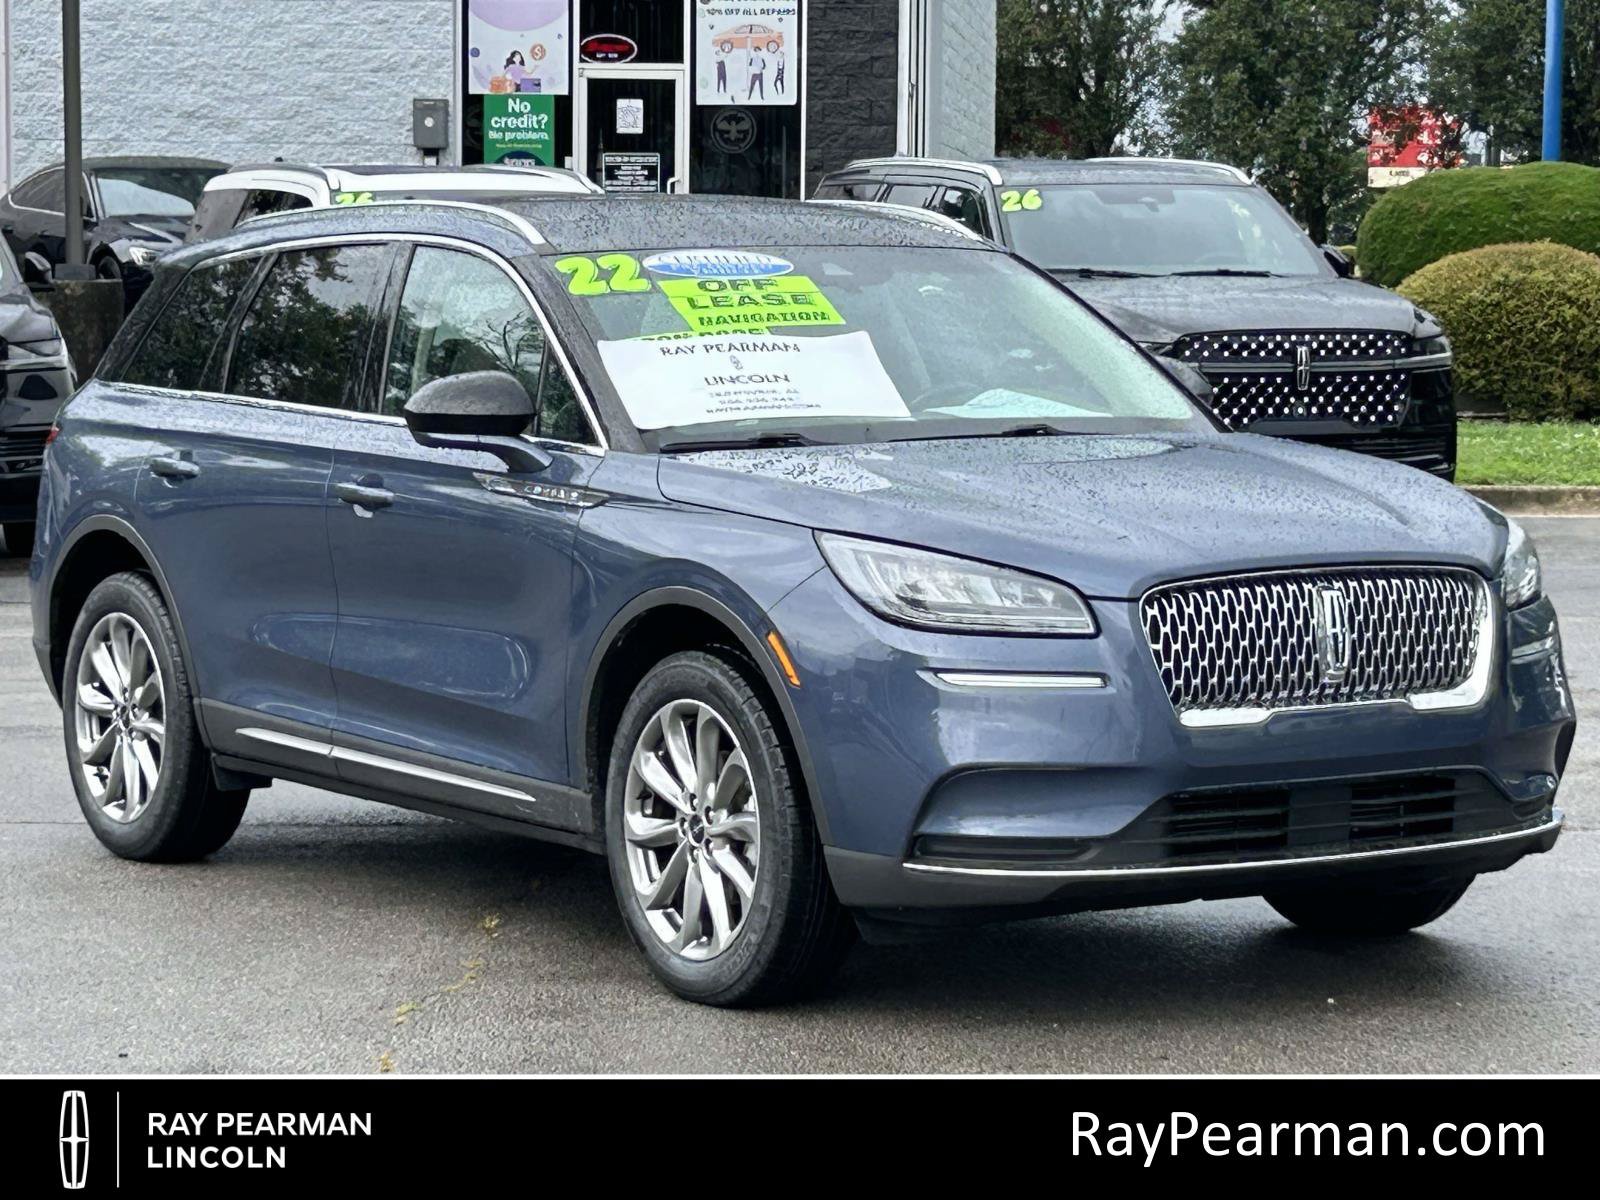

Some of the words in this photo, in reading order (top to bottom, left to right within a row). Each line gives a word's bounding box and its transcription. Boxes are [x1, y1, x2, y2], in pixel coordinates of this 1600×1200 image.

[507, 97, 531, 114] No
[490, 113, 549, 129] credit?
[1000, 188, 1042, 212] 26
[554, 254, 652, 297] 22
[697, 279, 779, 292] OFF
[686, 294, 817, 310] LEASE
[697, 311, 831, 327] NAVIGATION
[660, 344, 697, 356] RAY
[702, 341, 802, 354] PEARMAN
[703, 373, 791, 386] LINCOLN
